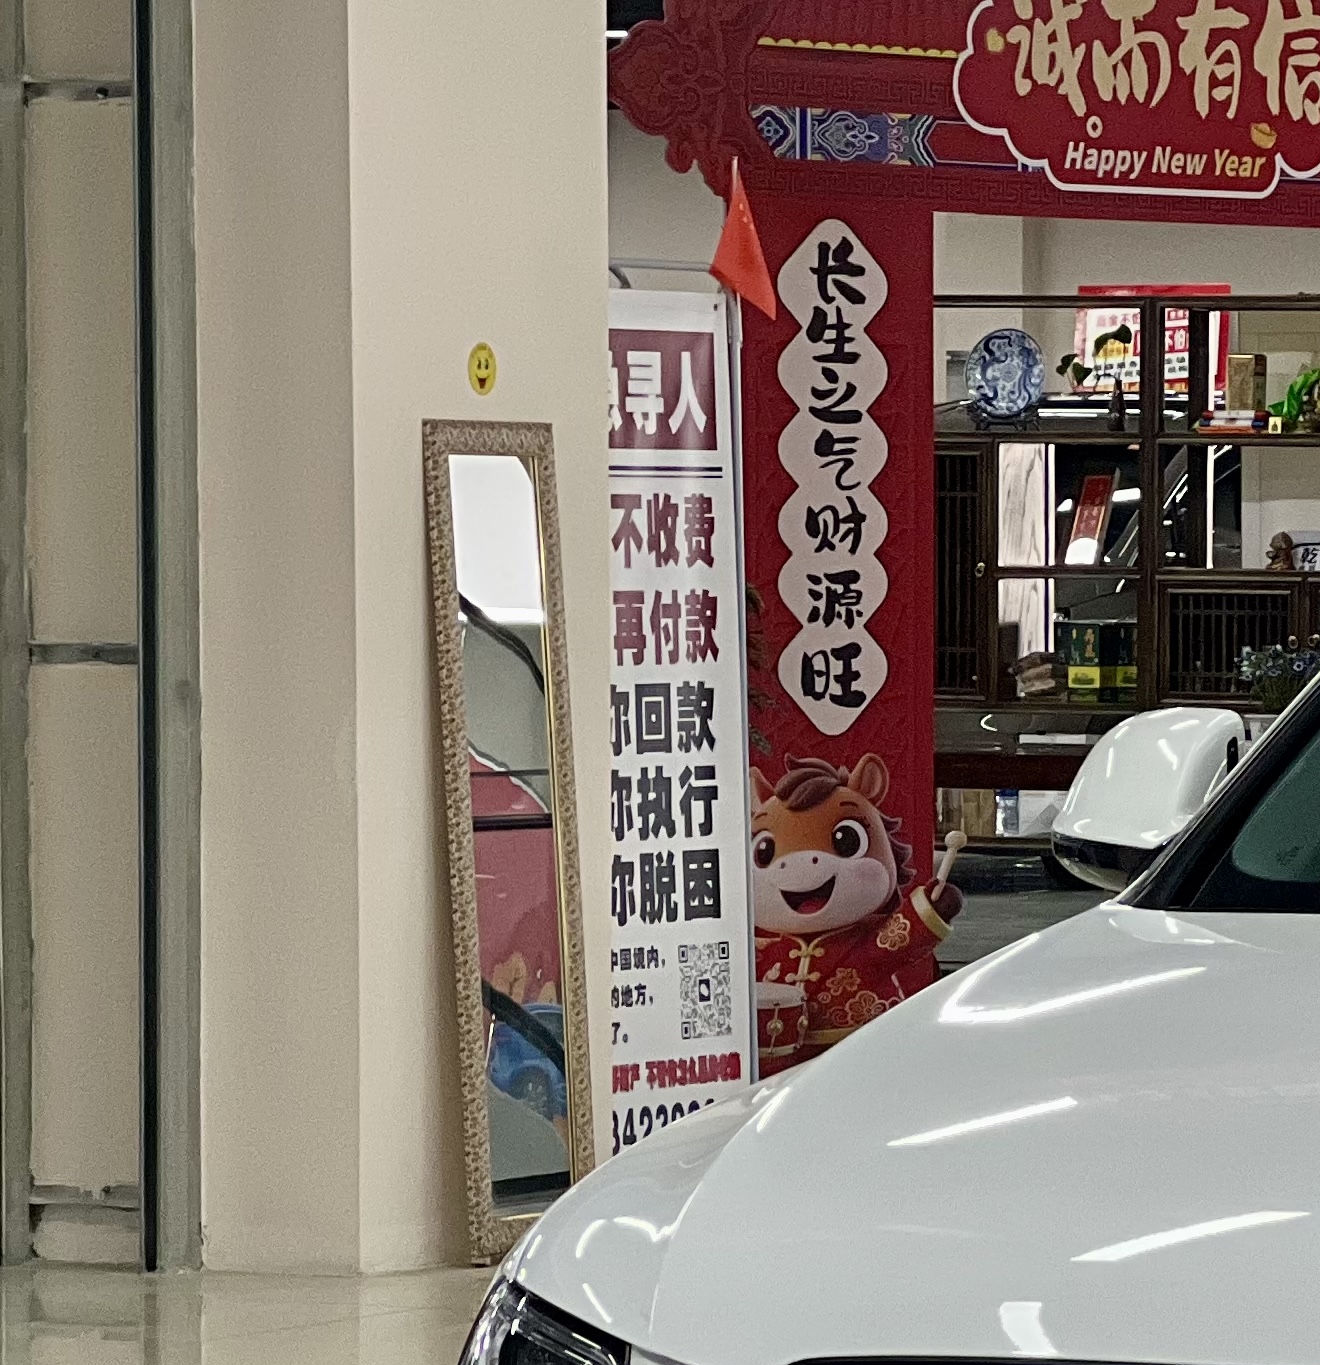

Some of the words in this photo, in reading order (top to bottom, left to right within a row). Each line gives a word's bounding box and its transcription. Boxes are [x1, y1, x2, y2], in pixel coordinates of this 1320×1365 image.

[1064, 141, 1149, 179] Happy
[1151, 146, 1205, 175] New
[1213, 148, 1266, 178] Year
[611, 492, 716, 569] 不收费
[613, 588, 719, 667] 再付款
